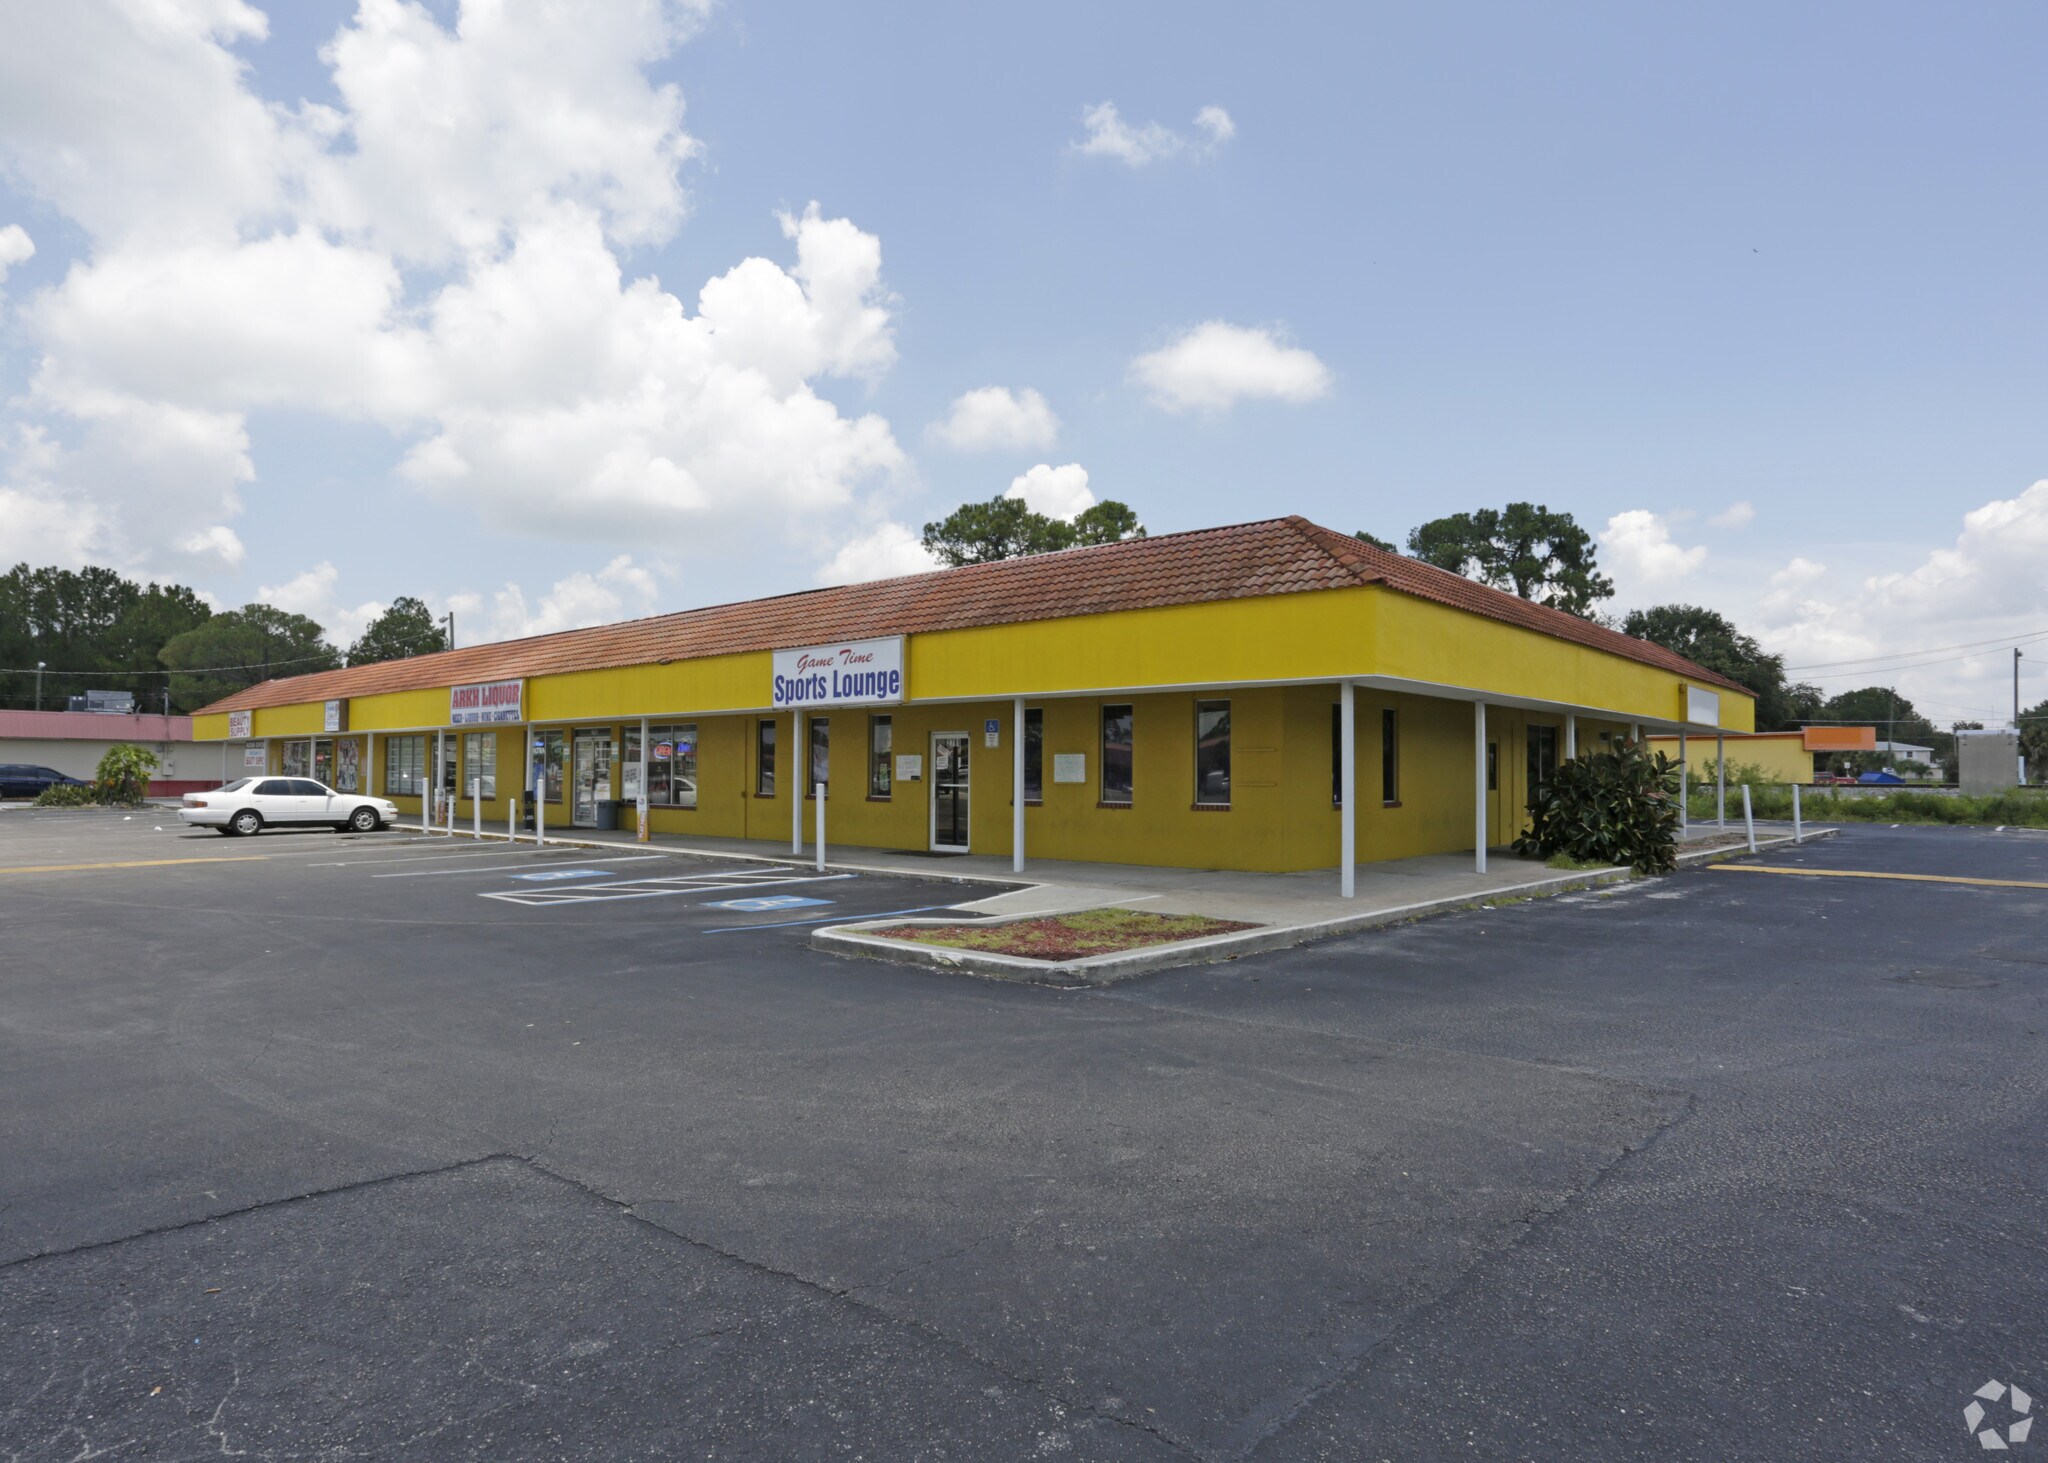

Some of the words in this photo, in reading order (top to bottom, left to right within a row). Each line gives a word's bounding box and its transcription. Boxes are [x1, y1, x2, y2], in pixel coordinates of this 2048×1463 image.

[797, 654, 834, 675] Game
[838, 648, 874, 666] Time
[452, 688, 479, 709] ARKH
[482, 683, 520, 709] LIQUOR
[774, 673, 827, 705] Sports
[833, 669, 899, 699] Lounge
[230, 716, 249, 727] BEAUTY
[230, 726, 249, 737] SUPPLY
